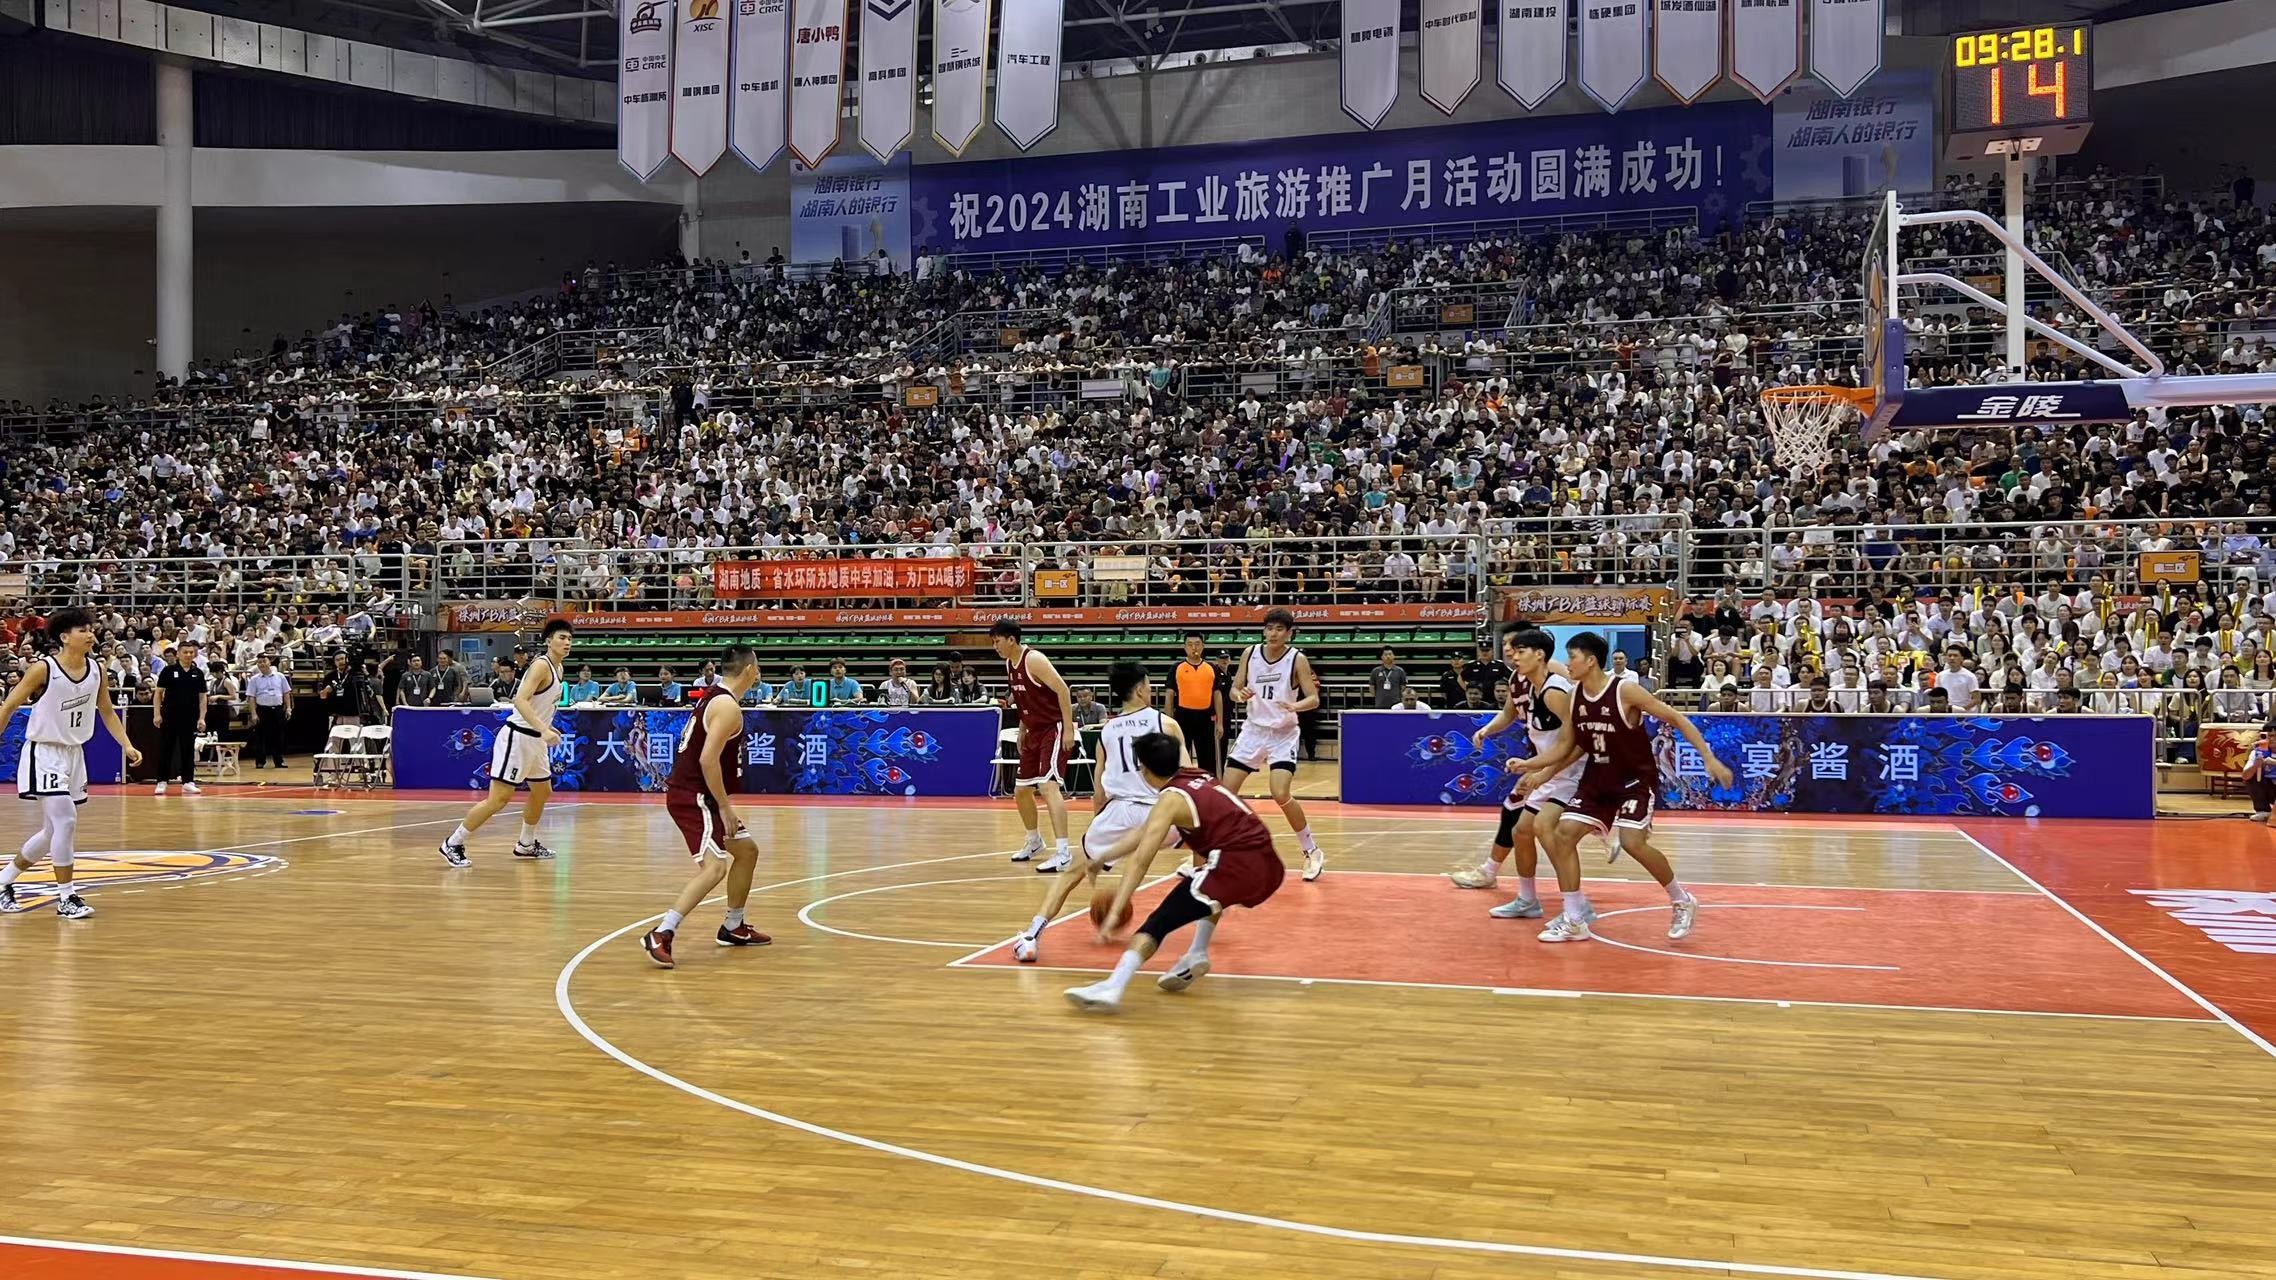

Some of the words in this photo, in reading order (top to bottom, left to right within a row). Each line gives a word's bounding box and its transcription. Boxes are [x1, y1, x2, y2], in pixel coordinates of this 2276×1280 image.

[759, 5, 784, 14] CRRC
[1509, 7, 1557, 19] 湖南建投
[693, 23, 715, 32] XISC
[796, 26, 840, 44] 唐小鸭
[1955, 28, 2083, 67] 09:28.1
[642, 61, 667, 70] CRRC
[1007, 54, 1051, 66] 汽车工程
[1990, 60, 2068, 126] 14
[1805, 96, 1898, 121] 湖南银行
[1787, 120, 1918, 148] 湖南人的银行
[814, 174, 883, 194] 湖南银行
[799, 195, 899, 218] 湖南人的银行
[1977, 395, 2064, 418] 金陵
[811, 681, 826, 707] 0
[70, 711, 83, 728] 12
[43, 774, 60, 790] 12
